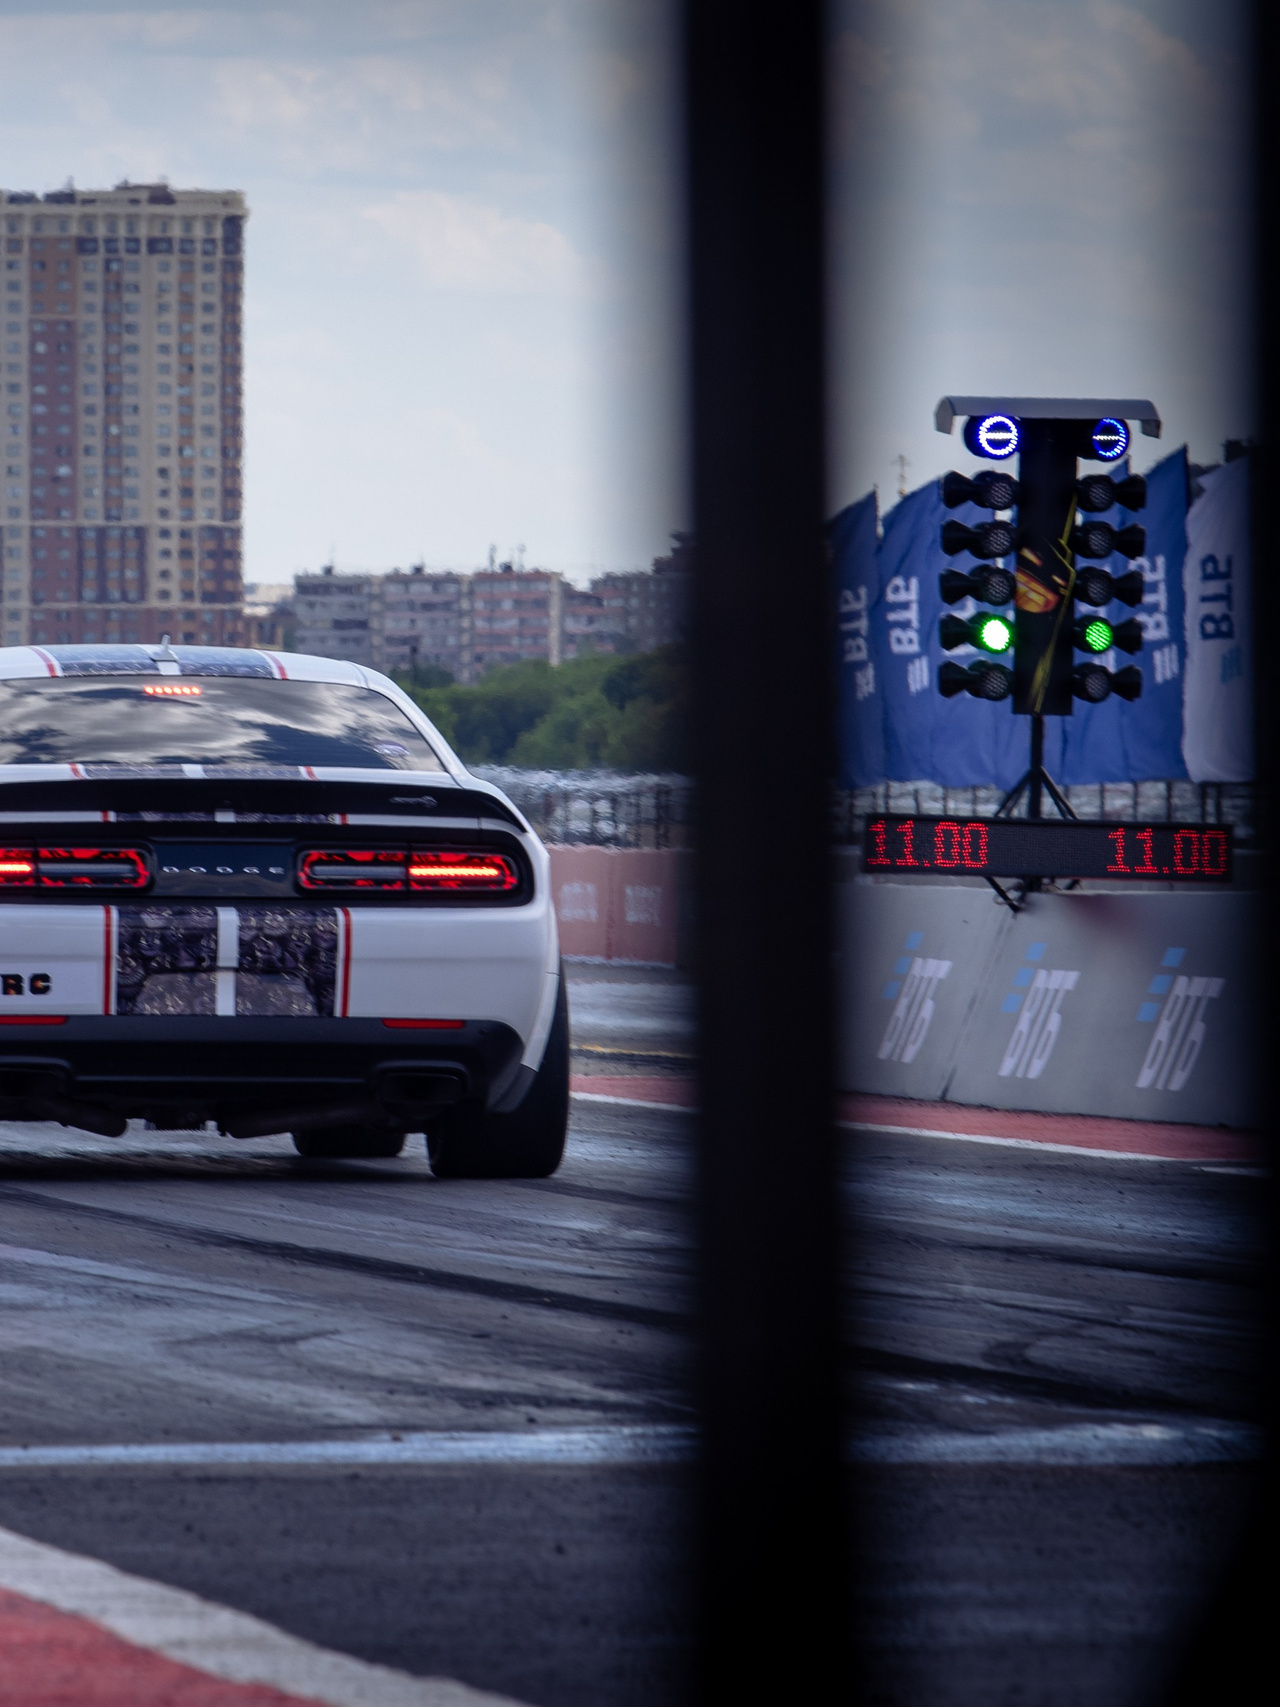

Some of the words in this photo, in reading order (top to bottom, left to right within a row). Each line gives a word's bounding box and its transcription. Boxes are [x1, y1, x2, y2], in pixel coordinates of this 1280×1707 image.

[867, 819, 989, 869] 11.00
[1106, 826, 1229, 875] 11.00
[162, 865, 285, 875] DODGE
